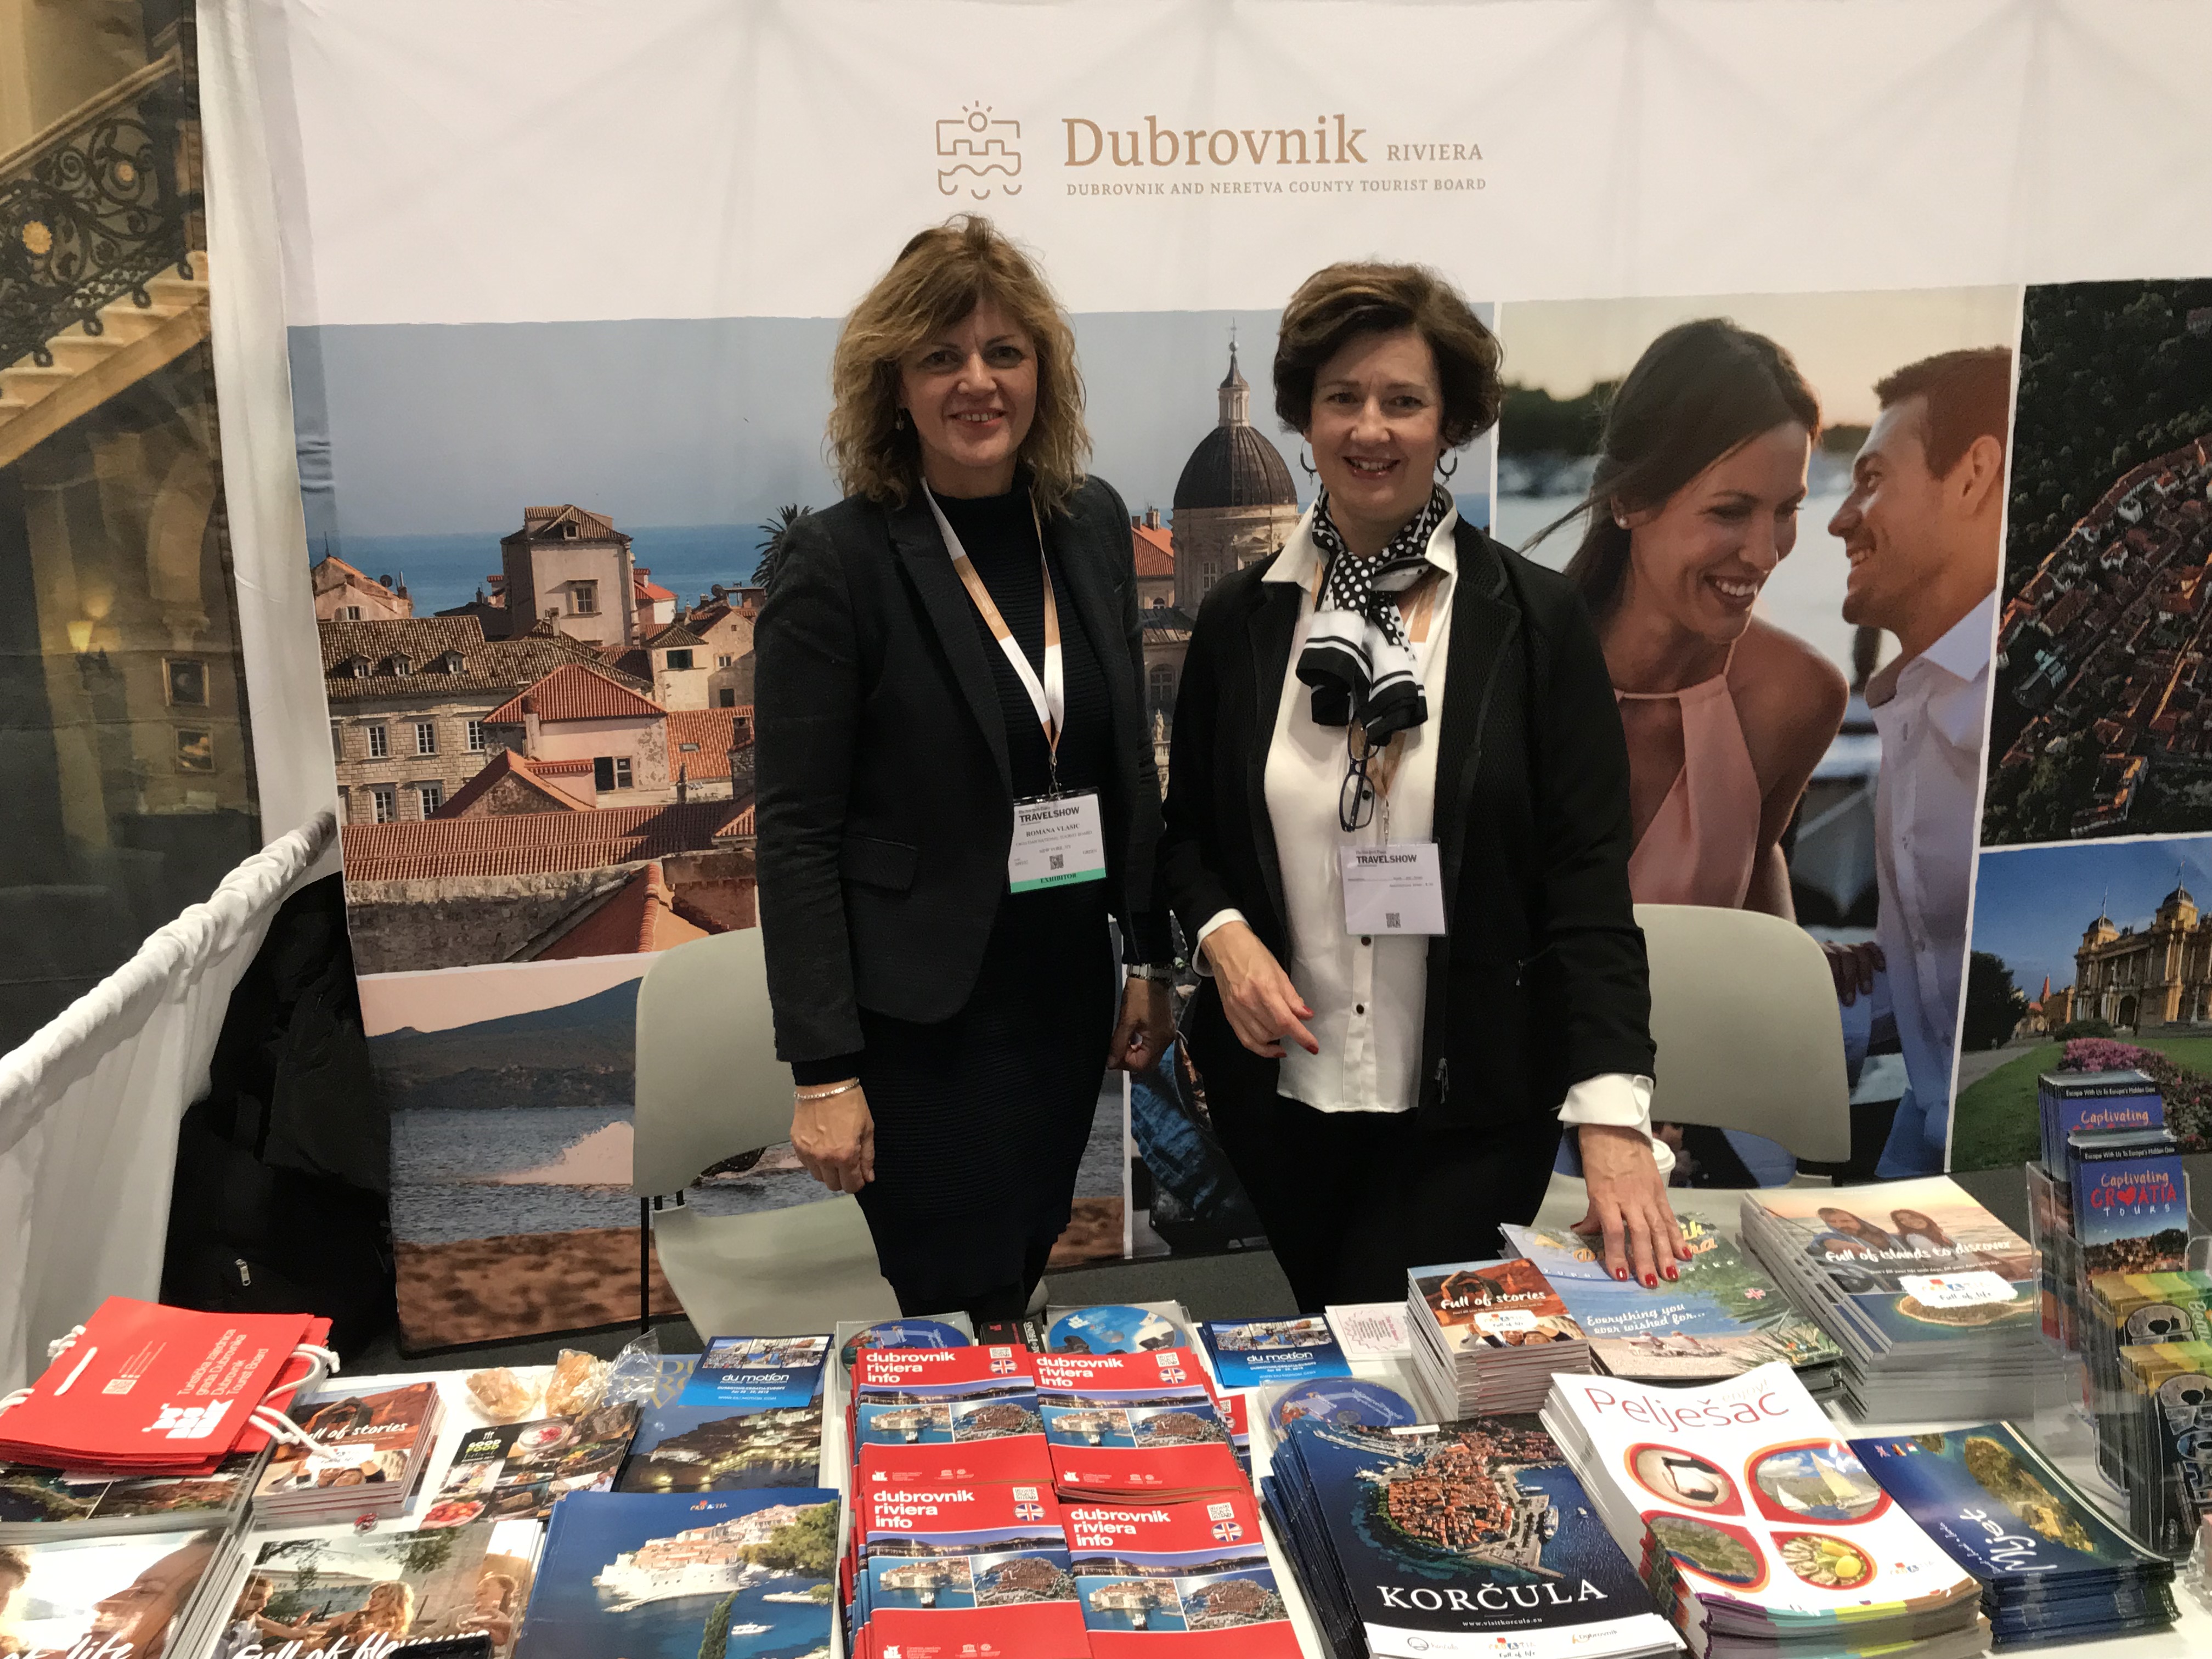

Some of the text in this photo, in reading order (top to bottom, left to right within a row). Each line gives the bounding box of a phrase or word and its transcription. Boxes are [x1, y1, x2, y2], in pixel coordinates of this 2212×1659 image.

[1062, 114, 1483, 168] Dubrovnik RIVIERA
[1066, 178, 1487, 196] DUBROVNIK AND NERETVA COUNTY TOURIST BOARD
[1026, 823, 1080, 837] ROMANA VLASIC
[1040, 873, 1076, 884] EXHIBITOR
[2081, 1108, 2149, 1126] Captivating
[2101, 1169, 2169, 1189] Captivating
[1825, 1240, 2012, 1262] Full of islands to discover
[1441, 1291, 1546, 1310] Full of stories
[1587, 1303, 1686, 1327] Everything you
[1594, 1326, 1621, 1334] ever
[1624, 1317, 1669, 1332] wished
[866, 1351, 956, 1362] dubrovnik
[1036, 1356, 1124, 1368] dubrovnik
[1246, 1351, 1313, 1362] du motion
[225, 1348, 270, 1396] Tourist Board
[866, 1364, 923, 1373] riviera
[1039, 1367, 1094, 1378] riviera
[210, 1359, 247, 1395] Dubrovnik
[741, 1373, 789, 1381] motion
[867, 1373, 900, 1384] info
[1041, 1376, 1073, 1387] info
[1584, 1387, 1790, 1434] Pelješac
[327, 1425, 349, 1440] of
[351, 1421, 409, 1436] stories
[465, 1444, 499, 1454] FOOD
[469, 1439, 502, 1448] GOOD
[873, 1489, 975, 1503] dubrovnik
[874, 1504, 938, 1516] riviera
[1070, 1508, 1171, 1523] dubrovnik
[875, 1516, 913, 1529] info
[1074, 1521, 1137, 1535] riviera
[1076, 1534, 1114, 1547] info
[1959, 1508, 2058, 1572] Mljet
[1376, 1578, 1607, 1611] KORČULA
[1462, 1617, 1543, 1627] www.visitkorcula.eu
